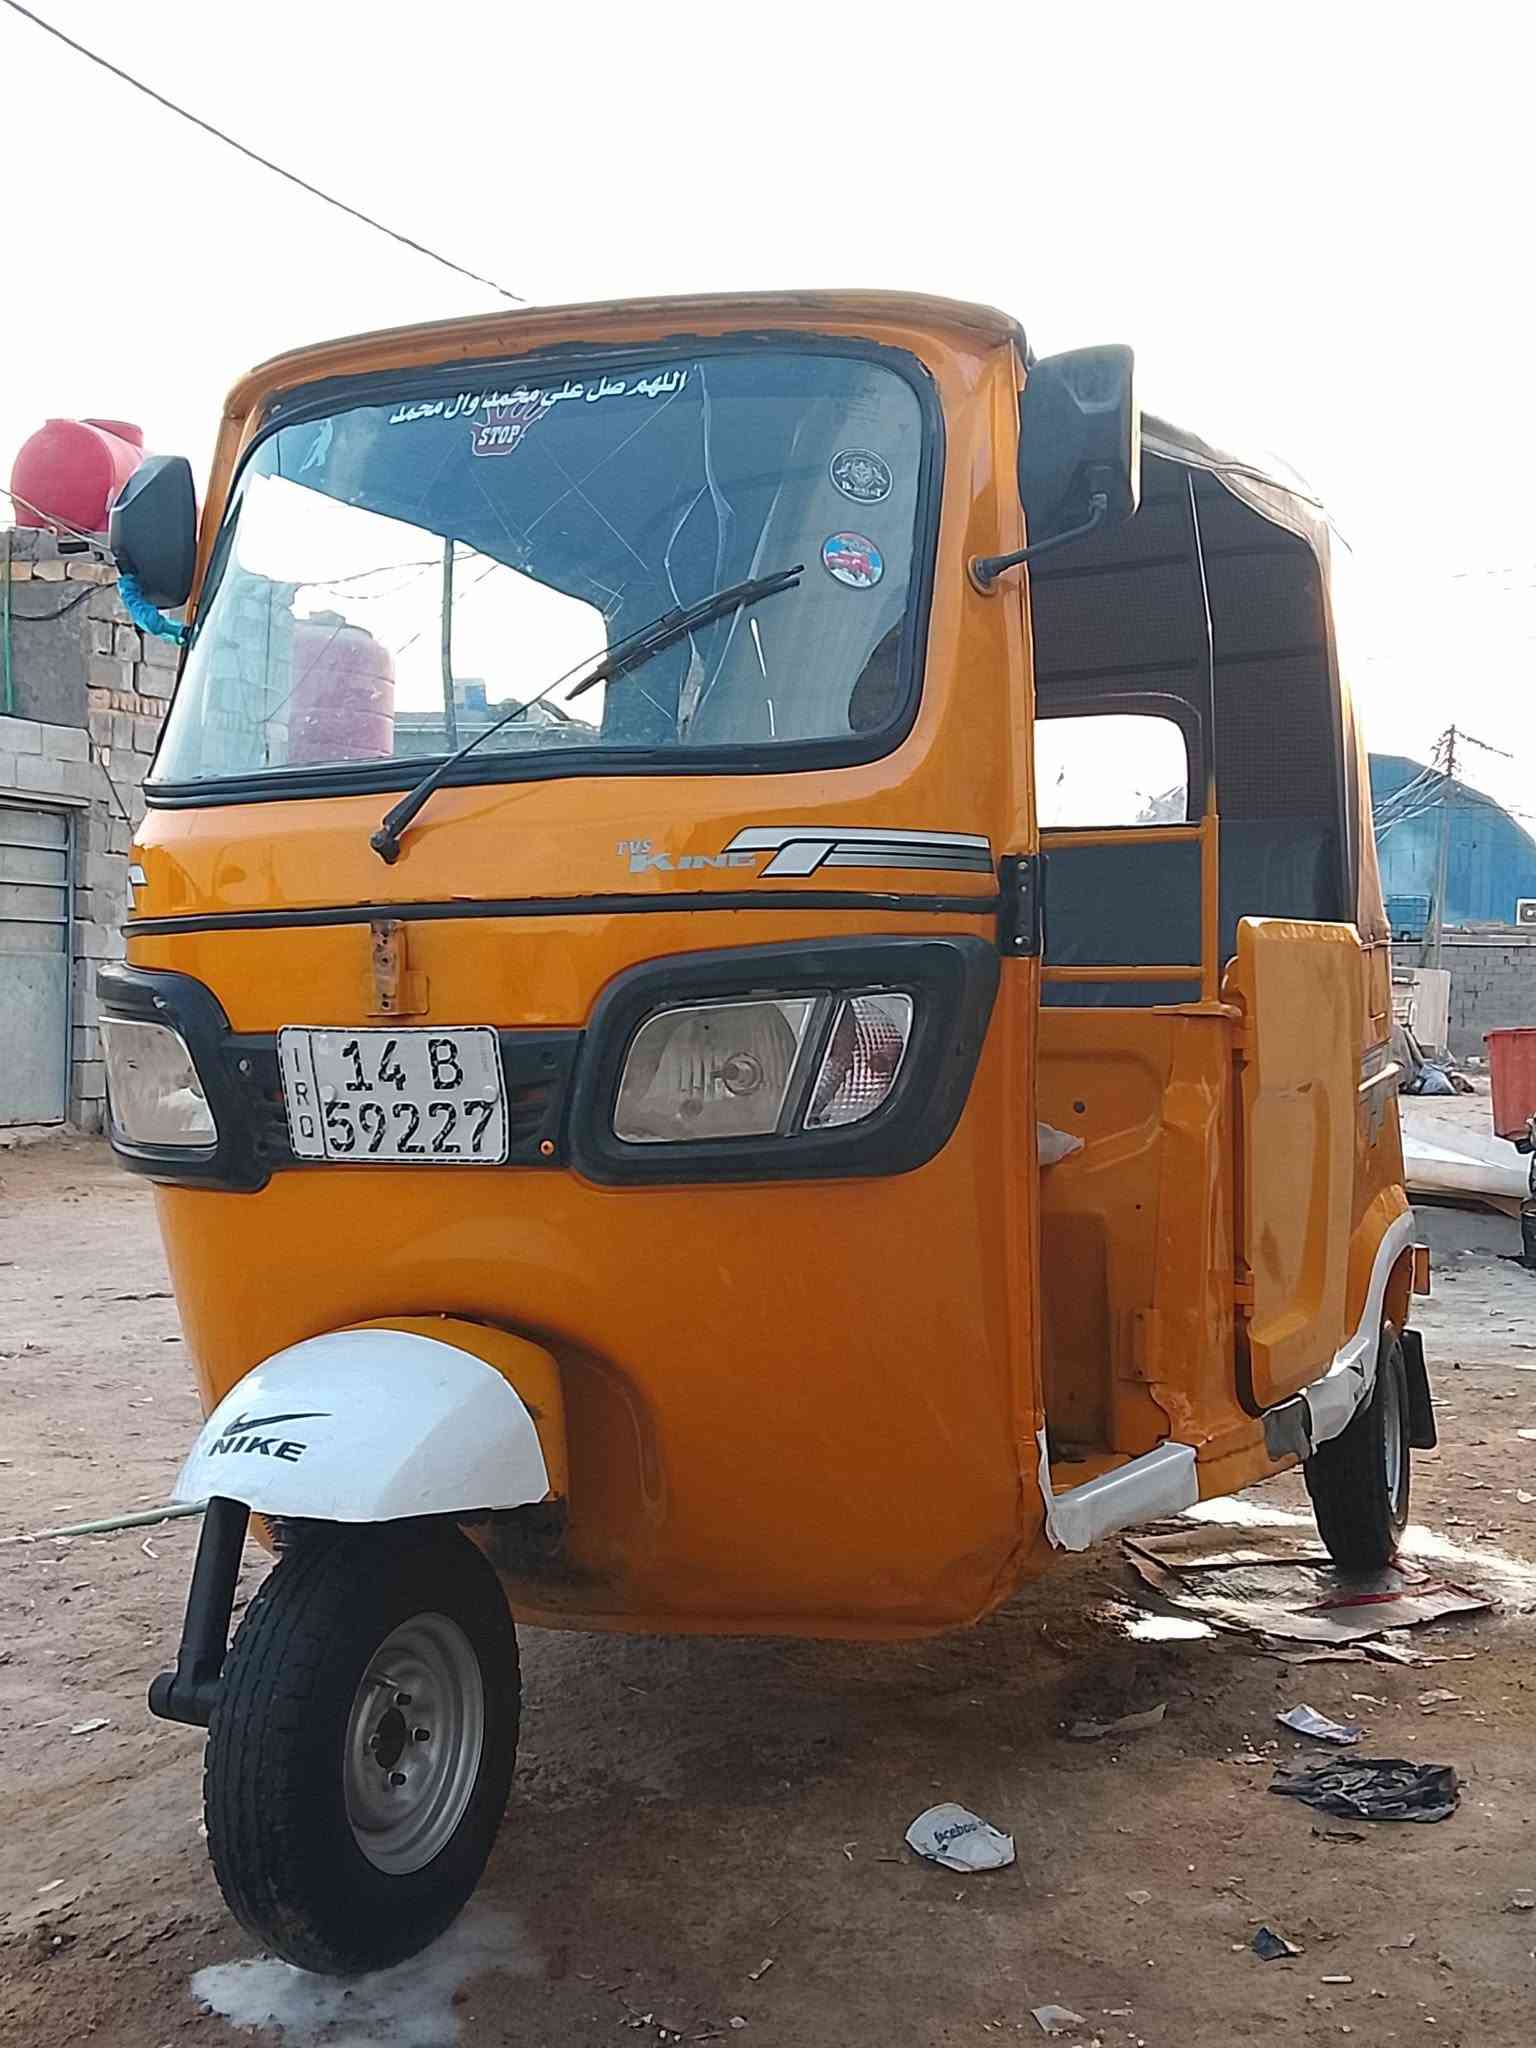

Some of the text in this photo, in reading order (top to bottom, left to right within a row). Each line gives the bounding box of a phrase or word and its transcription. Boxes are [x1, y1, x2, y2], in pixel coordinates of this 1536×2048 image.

[586, 376, 626, 402] صل
[627, 371, 688, 398] اللهم
[481, 388, 541, 409] محمد
[389, 401, 444, 424] محمد
[478, 425, 521, 446] STOP
[342, 1038, 464, 1092] 14 B
[324, 1099, 495, 1154] 59227
[208, 1436, 307, 1463] NIKE
